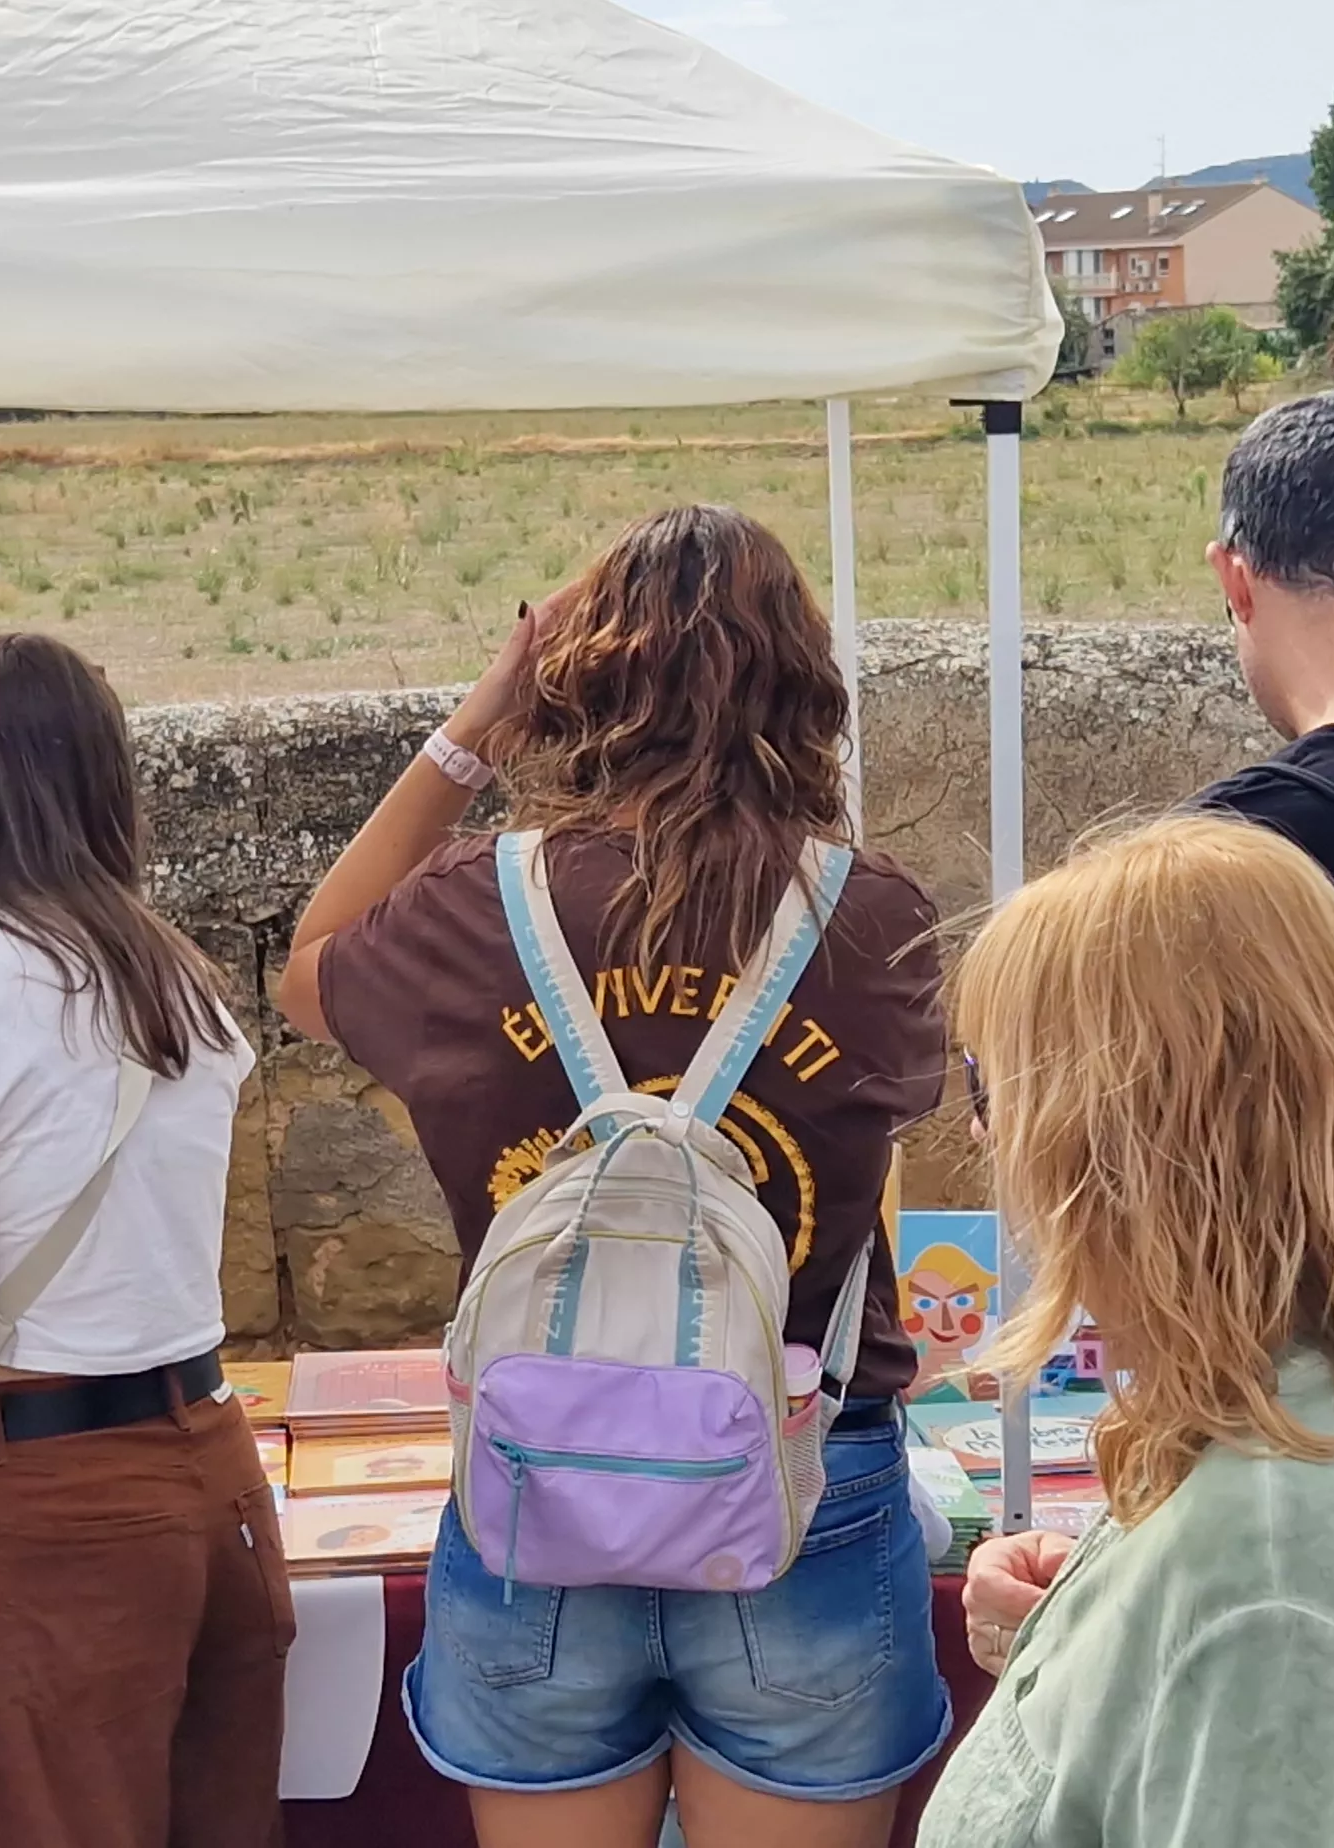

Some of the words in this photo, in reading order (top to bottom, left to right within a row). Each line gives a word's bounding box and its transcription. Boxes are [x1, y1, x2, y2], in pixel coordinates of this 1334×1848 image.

[525, 924, 612, 1091] MARTINEZ
[713, 909, 813, 1079] MARTINEZ
[782, 1018, 841, 1082] TI
[687, 1228, 721, 1359] MARTIN
